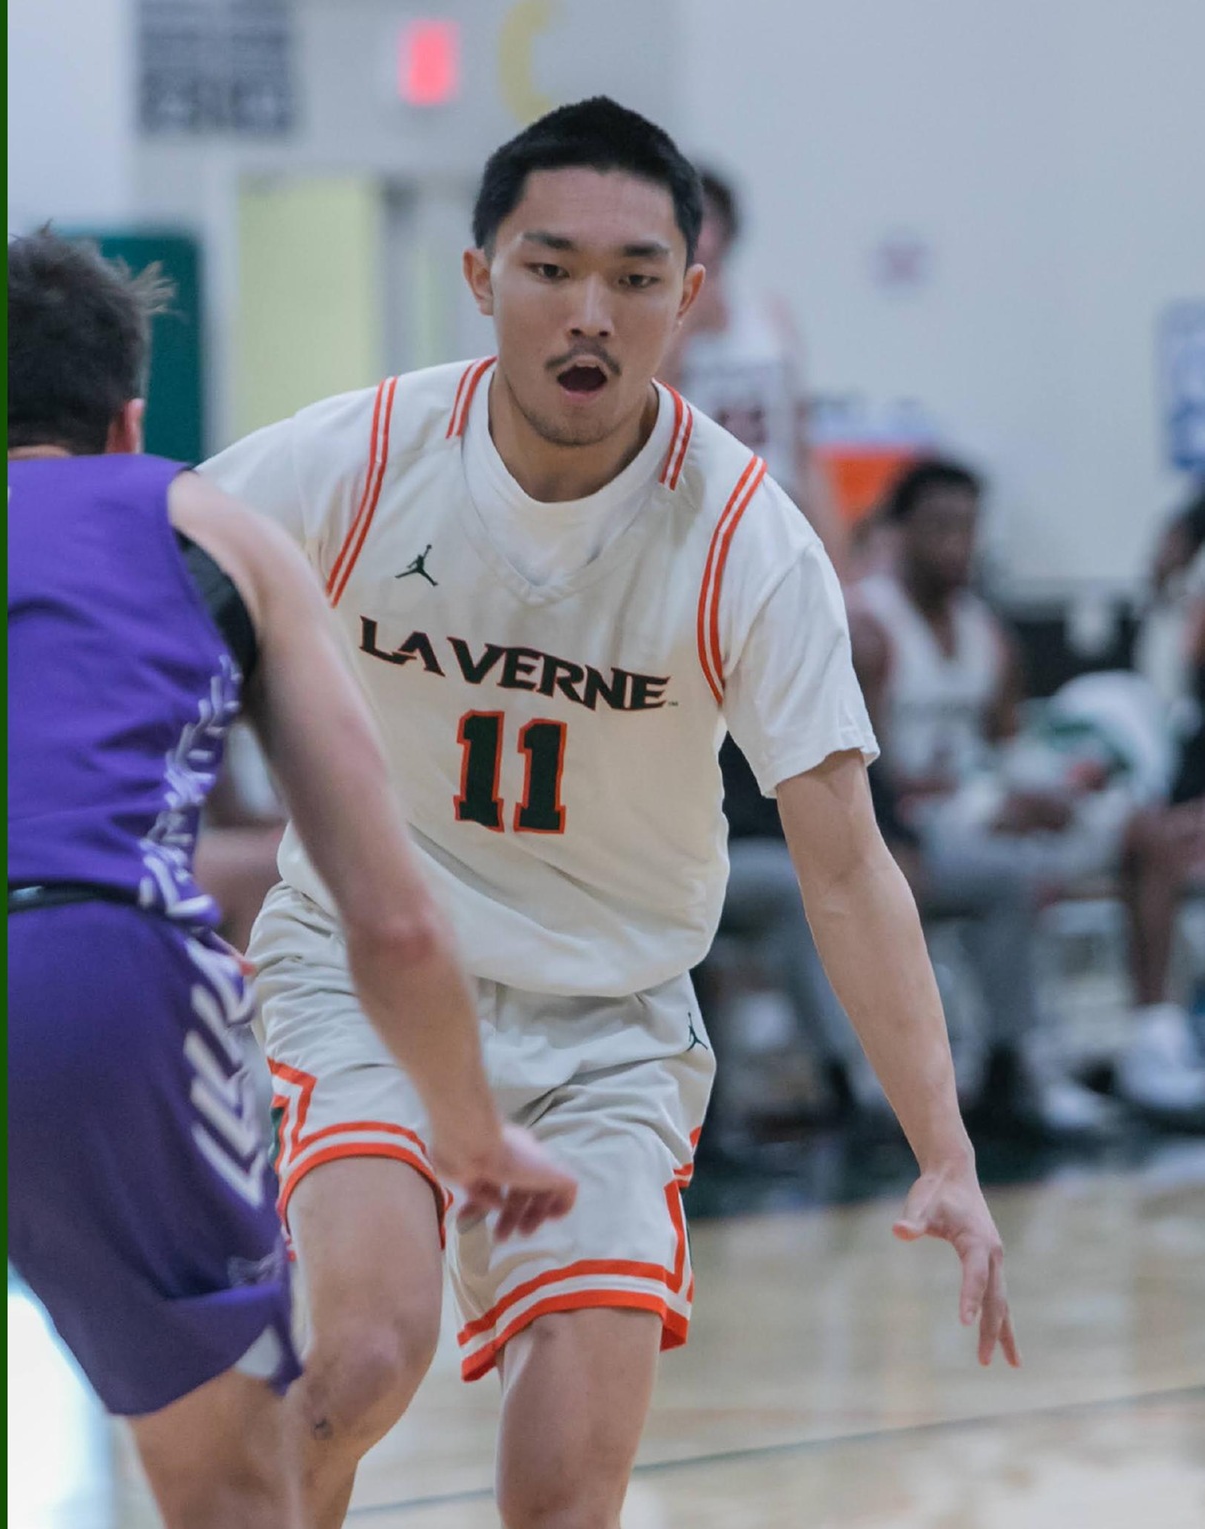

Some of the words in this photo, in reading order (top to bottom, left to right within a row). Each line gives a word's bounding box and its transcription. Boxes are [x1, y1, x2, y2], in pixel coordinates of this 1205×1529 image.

[359, 615, 445, 677] LA
[446, 636, 671, 711] VERNE
[453, 709, 567, 834] 11
